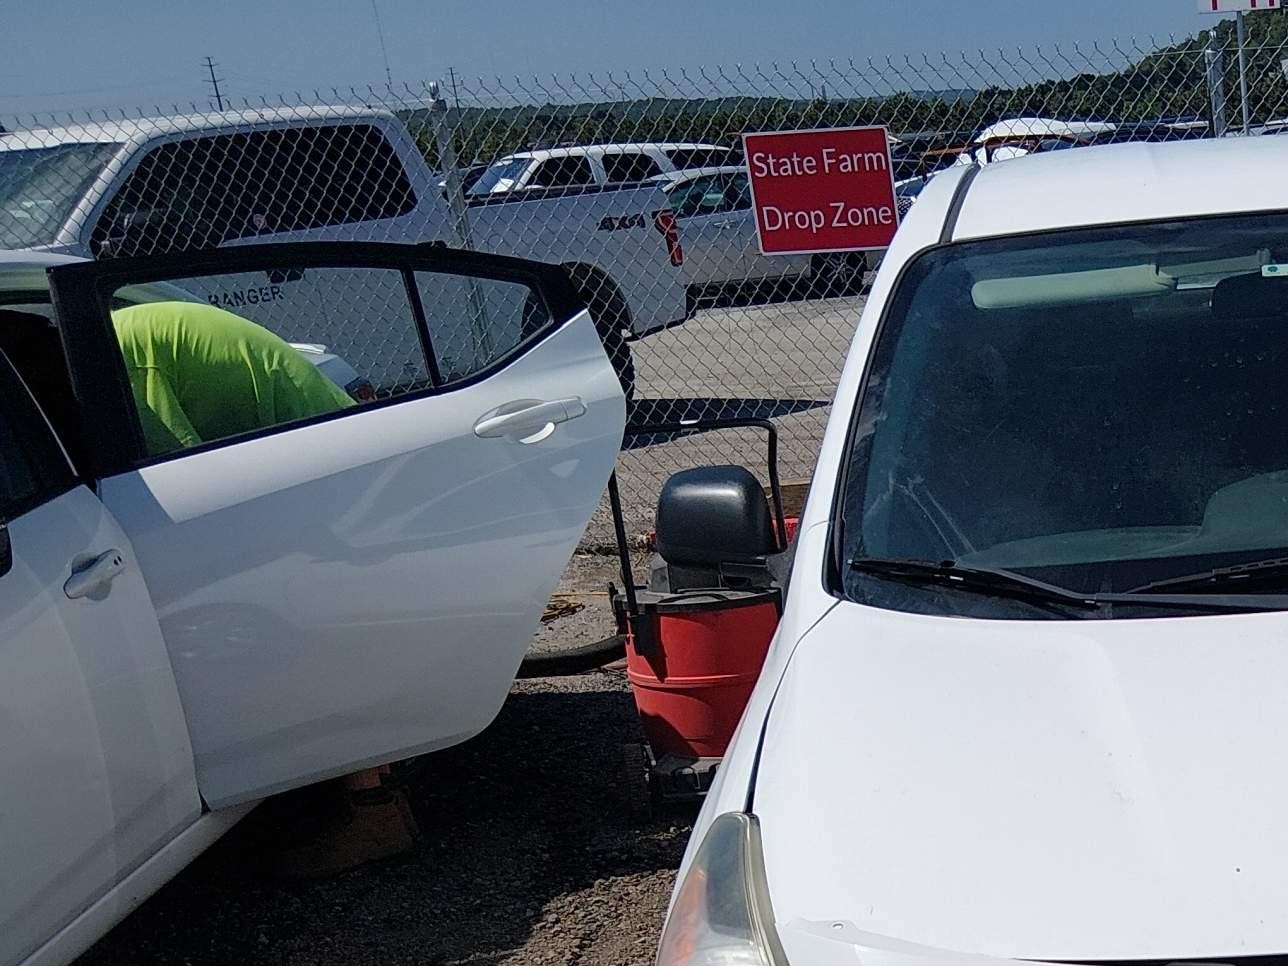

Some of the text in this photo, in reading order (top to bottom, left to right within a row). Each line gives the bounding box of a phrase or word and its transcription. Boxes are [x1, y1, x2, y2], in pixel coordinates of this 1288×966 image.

[752, 148, 887, 178] State Farm
[761, 202, 893, 234] Drop Zone
[208, 285, 284, 308] RANGER
